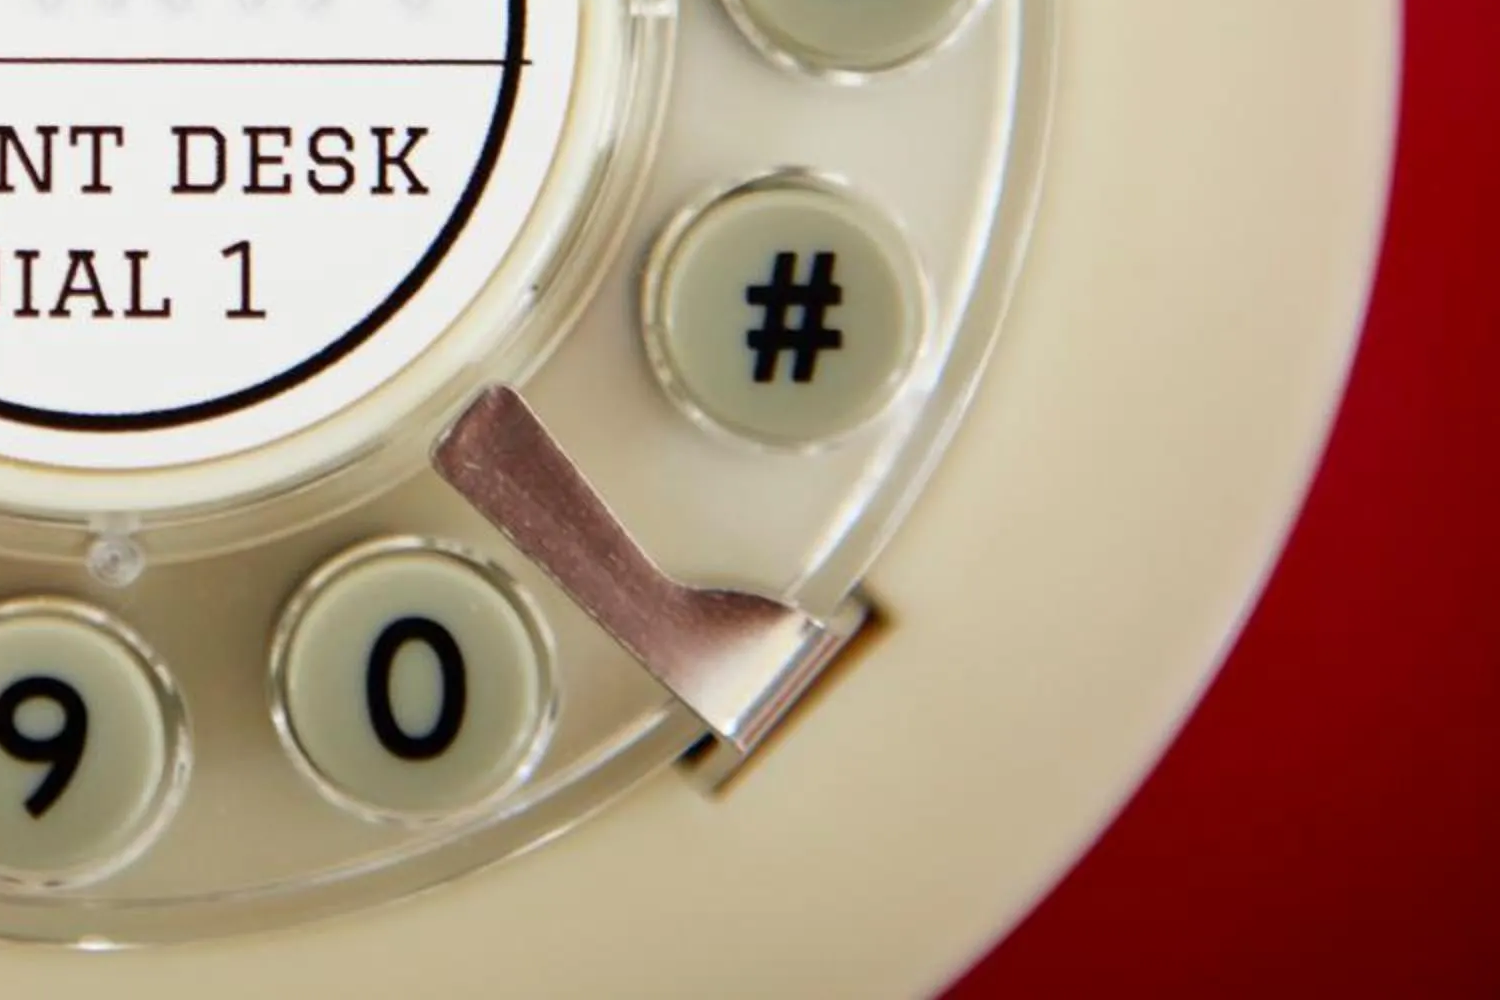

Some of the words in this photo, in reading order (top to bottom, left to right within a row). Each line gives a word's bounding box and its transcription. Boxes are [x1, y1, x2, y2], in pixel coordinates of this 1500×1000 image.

[171, 126, 430, 195] DESK
[221, 240, 267, 319] 1
[365, 616, 467, 762] 0
